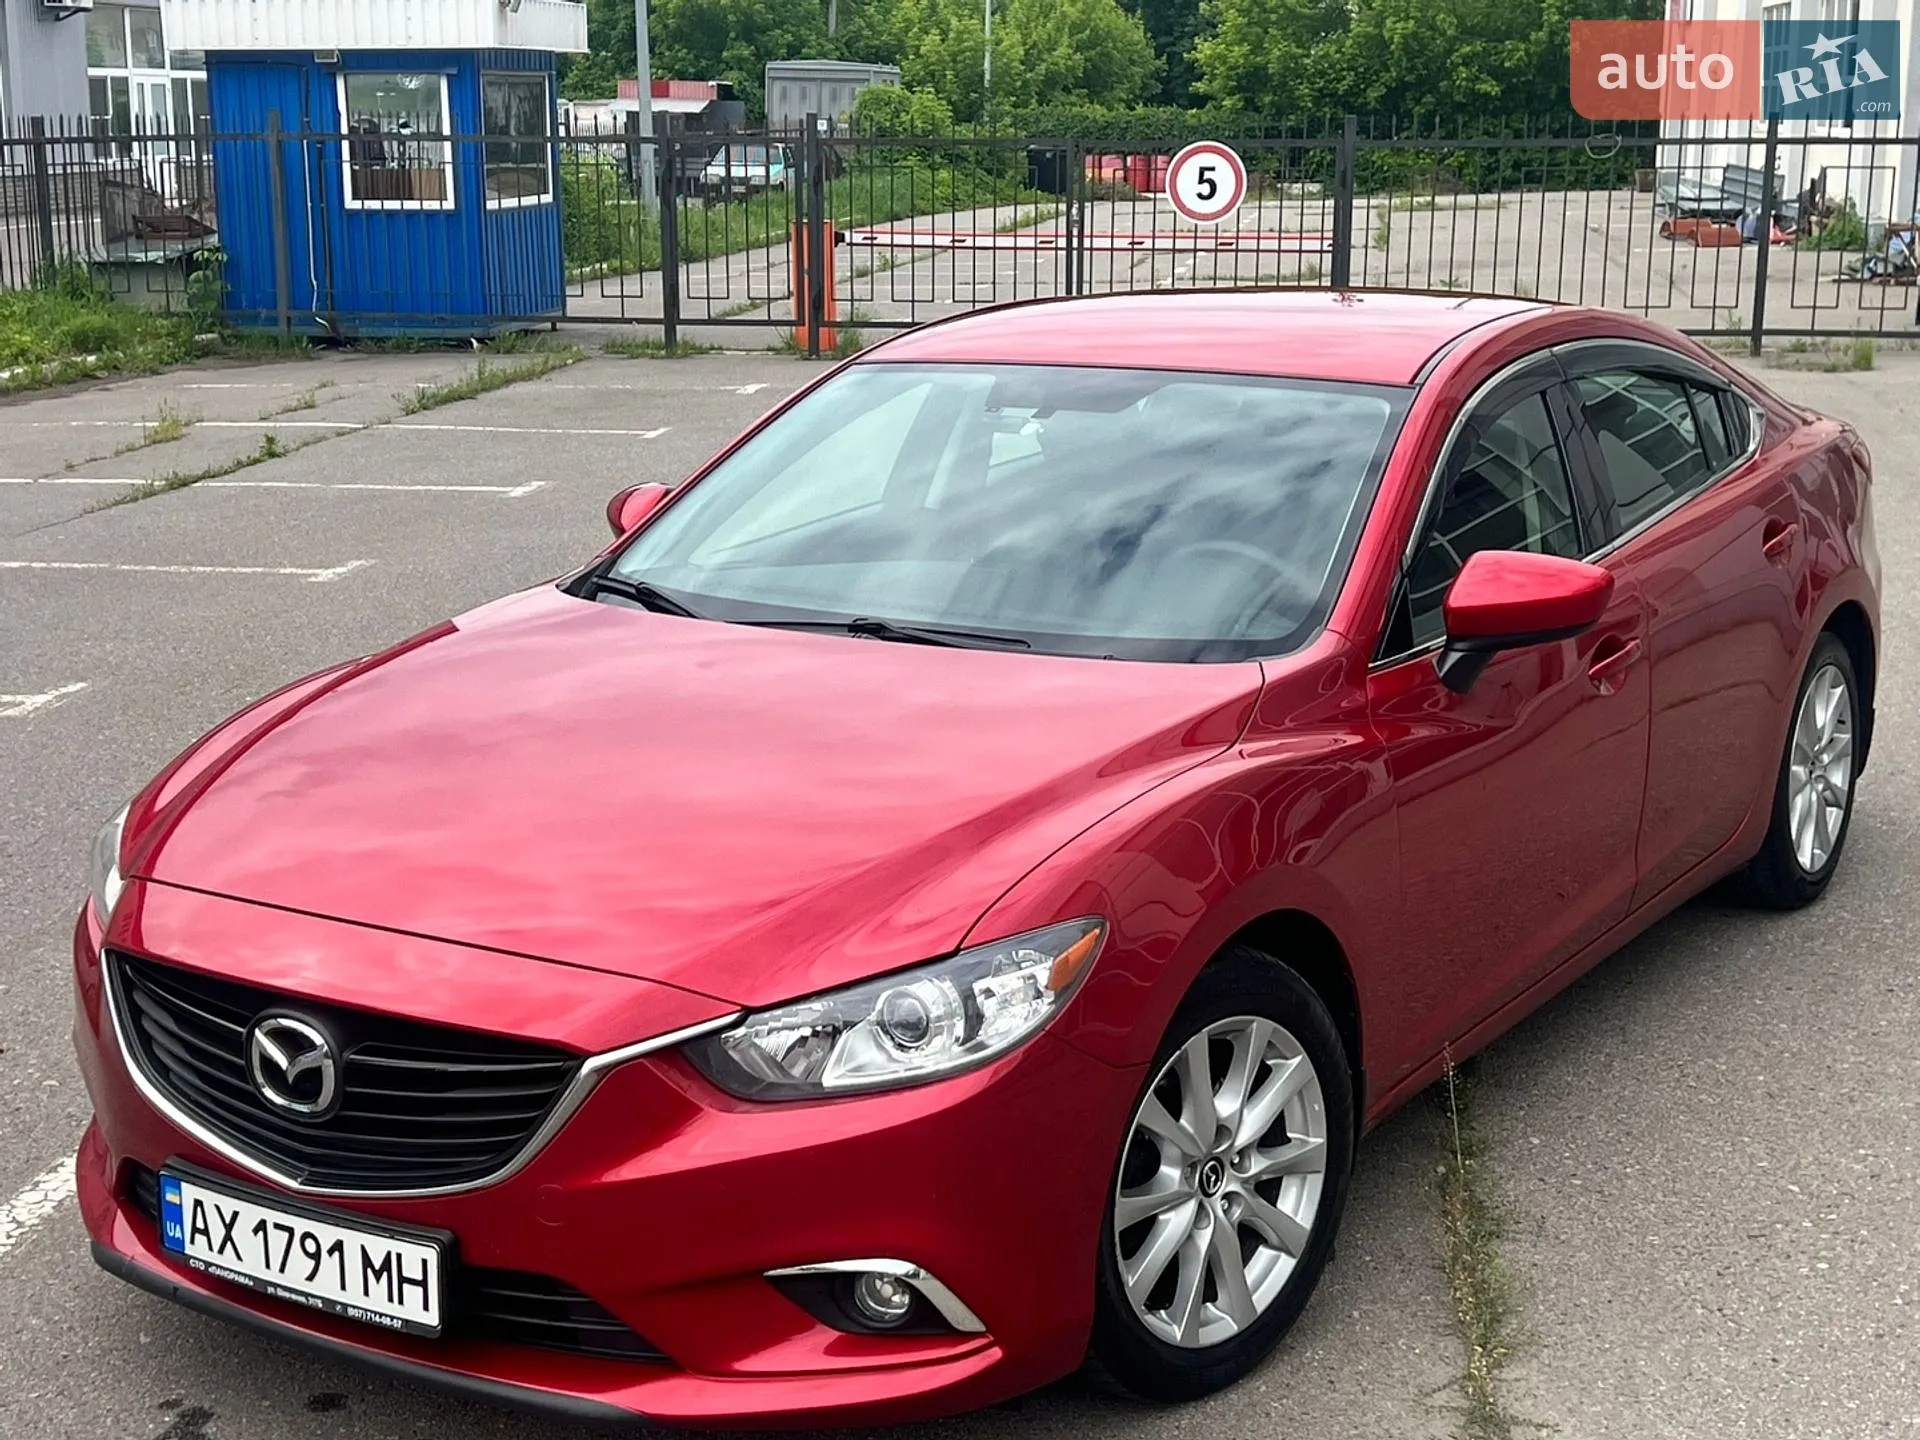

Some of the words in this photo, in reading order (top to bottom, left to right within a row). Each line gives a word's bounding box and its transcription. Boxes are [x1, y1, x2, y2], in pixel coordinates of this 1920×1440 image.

[1196, 166, 1218, 201] 5
[166, 1221, 183, 1240] UA
[189, 1198, 244, 1263] AX
[251, 1218, 347, 1292] 1791
[360, 1243, 430, 1312] MH
